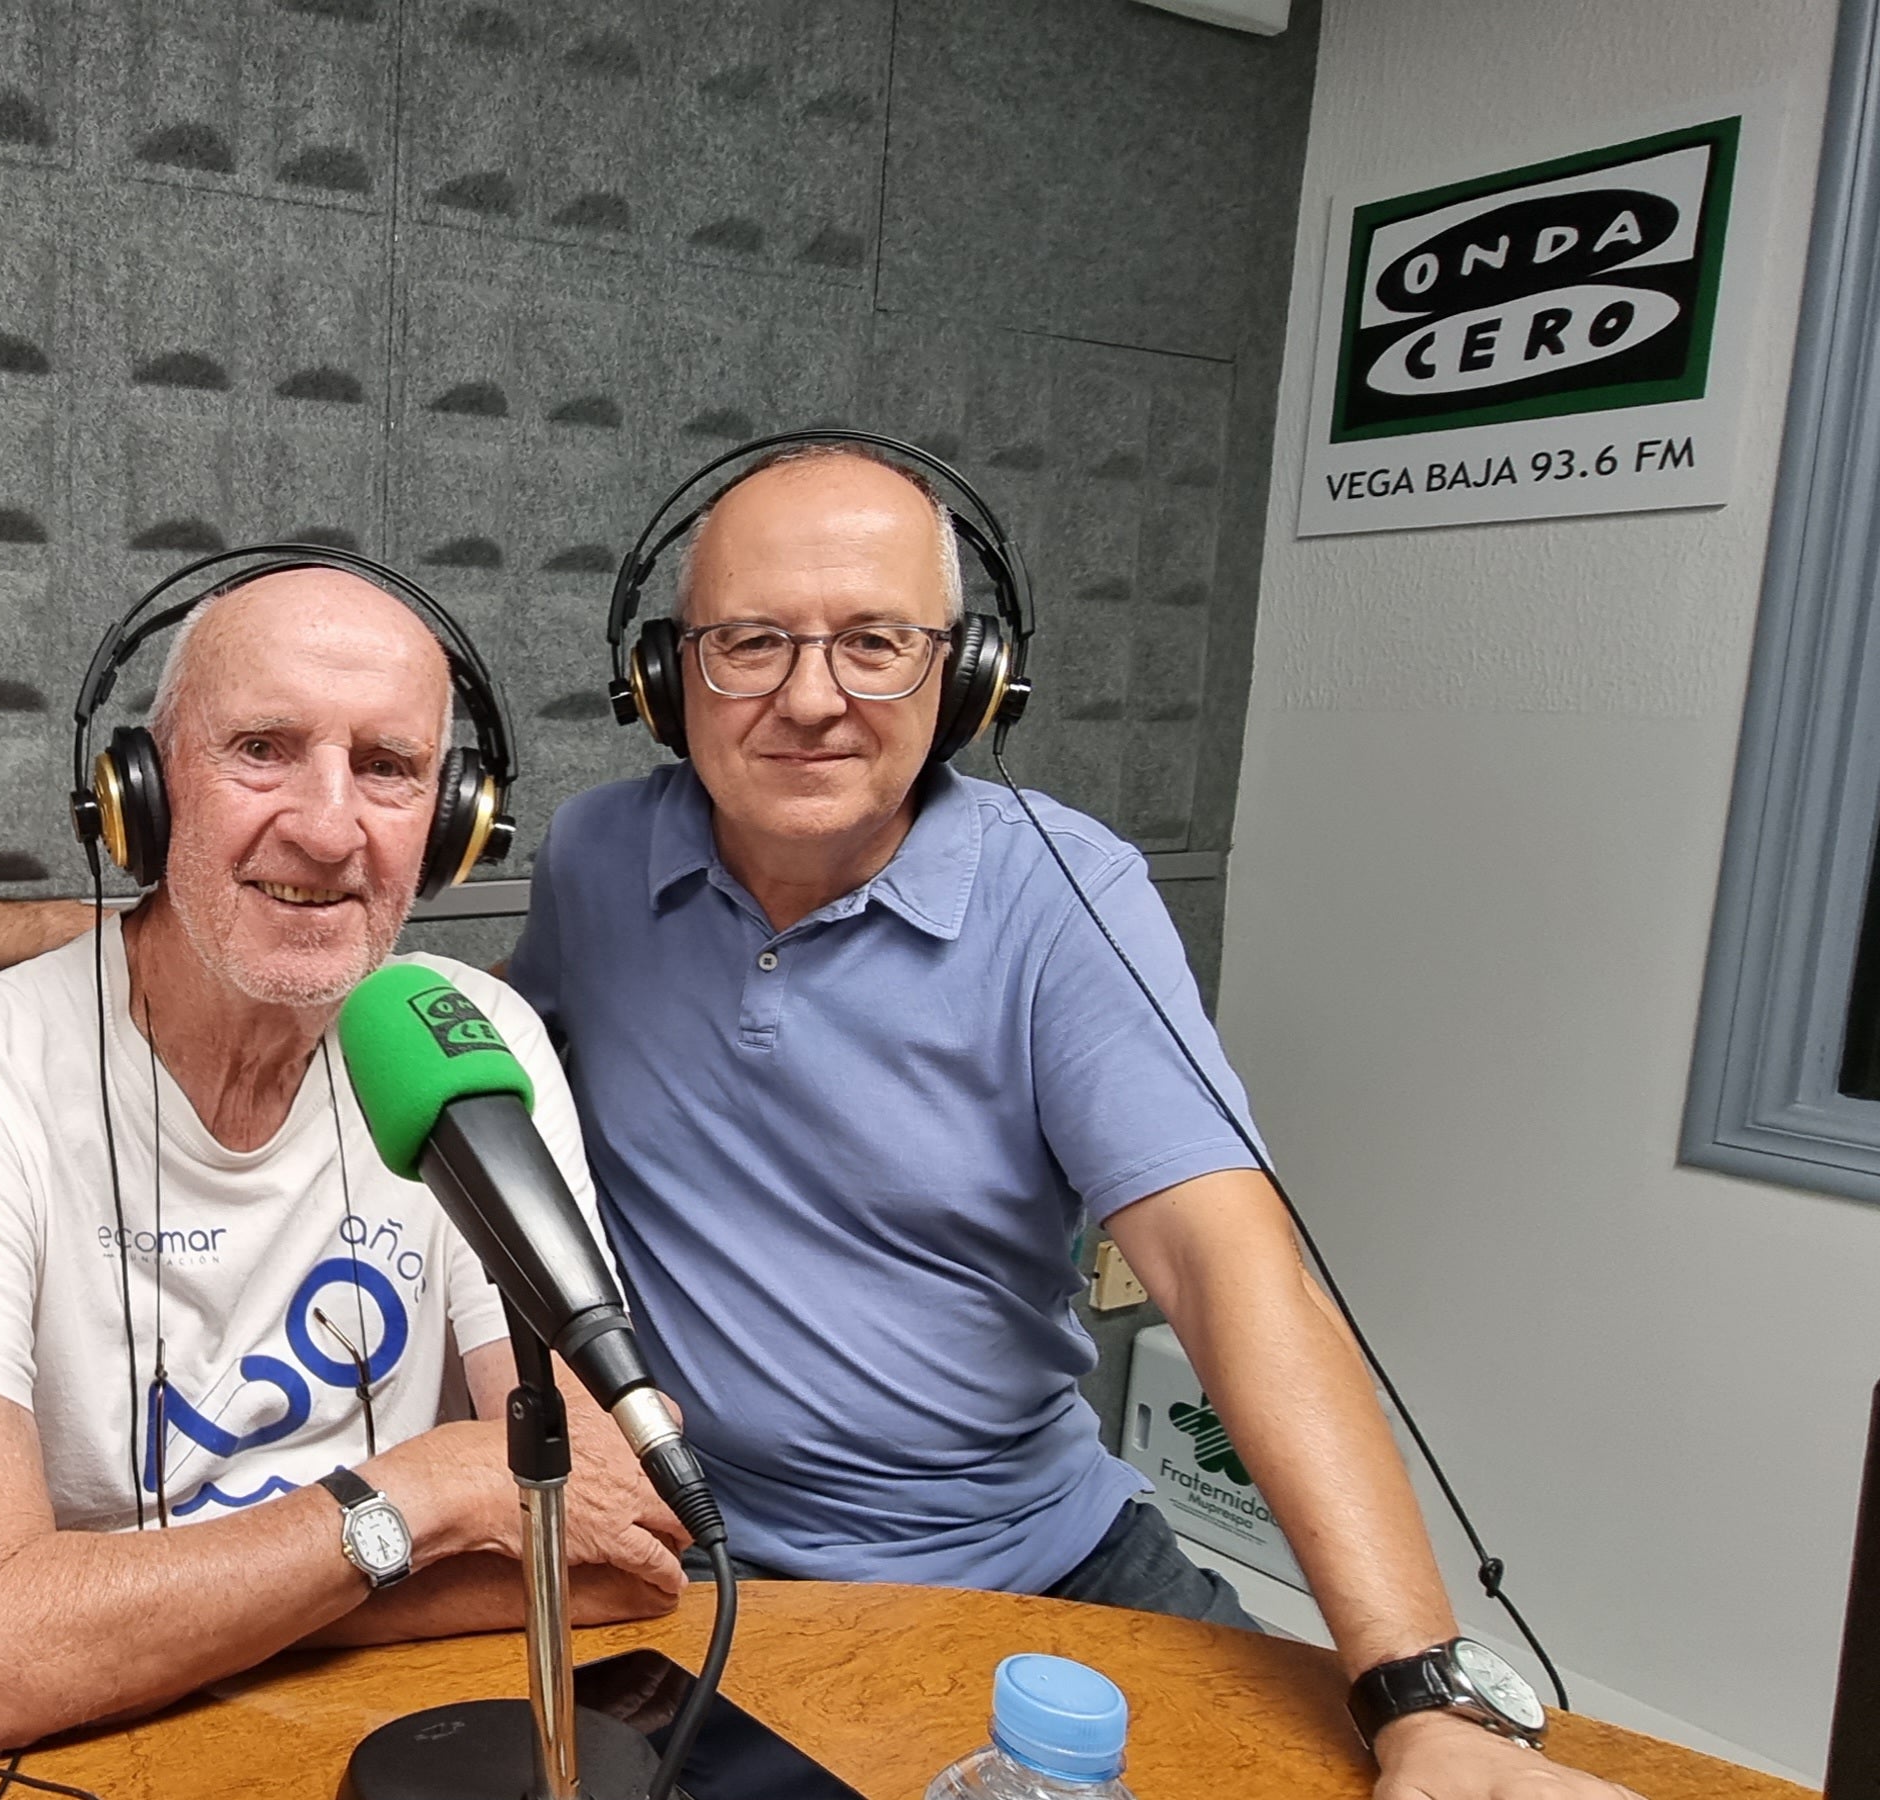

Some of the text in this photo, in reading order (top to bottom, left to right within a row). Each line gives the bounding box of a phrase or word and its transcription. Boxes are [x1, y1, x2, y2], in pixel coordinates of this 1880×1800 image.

[1404, 210, 1643, 294] ONDA
[1404, 300, 1635, 380] CERO
[1325, 437, 1695, 501] VEGA BAJA 93.6 FM
[98, 1225, 227, 1254] ecomar
